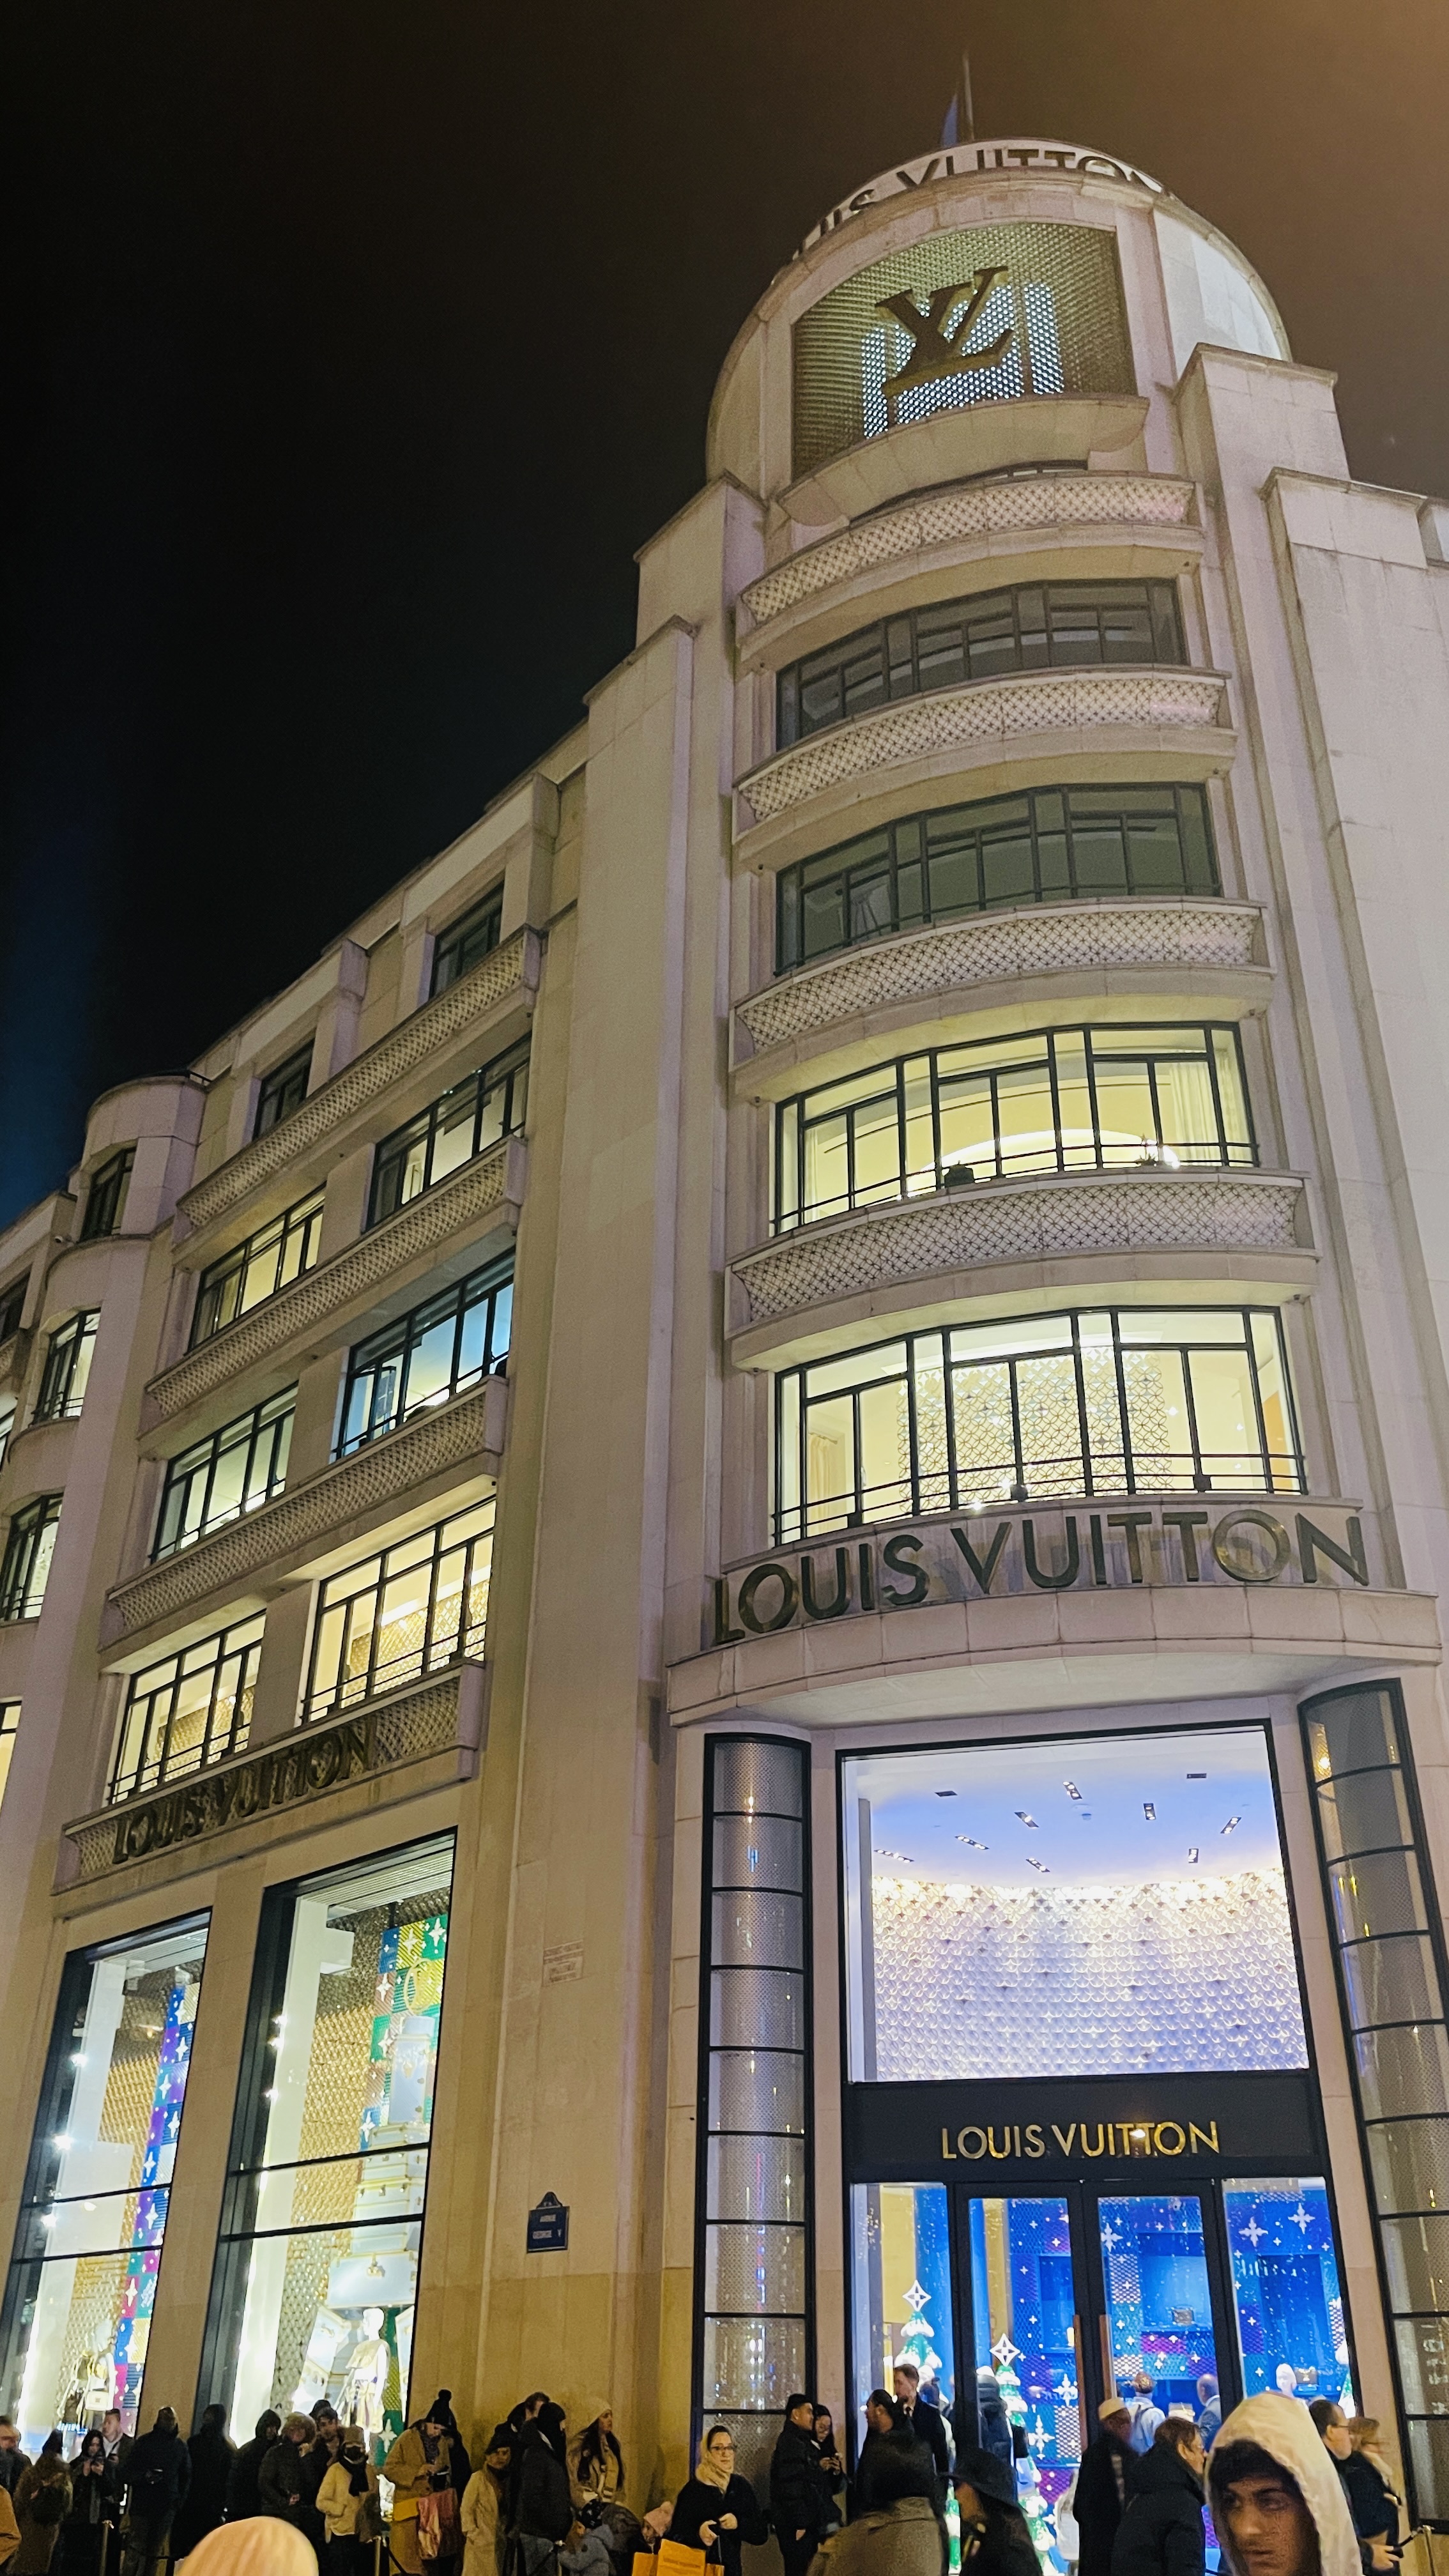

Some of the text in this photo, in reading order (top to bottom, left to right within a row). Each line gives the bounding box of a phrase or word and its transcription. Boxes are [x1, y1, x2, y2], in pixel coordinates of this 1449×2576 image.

[711, 1508, 1370, 1645] LOUIS VUITTON
[111, 1713, 378, 1865] LOUIS VUITTON
[942, 2120, 1220, 2159] LOUIS VUITTON
